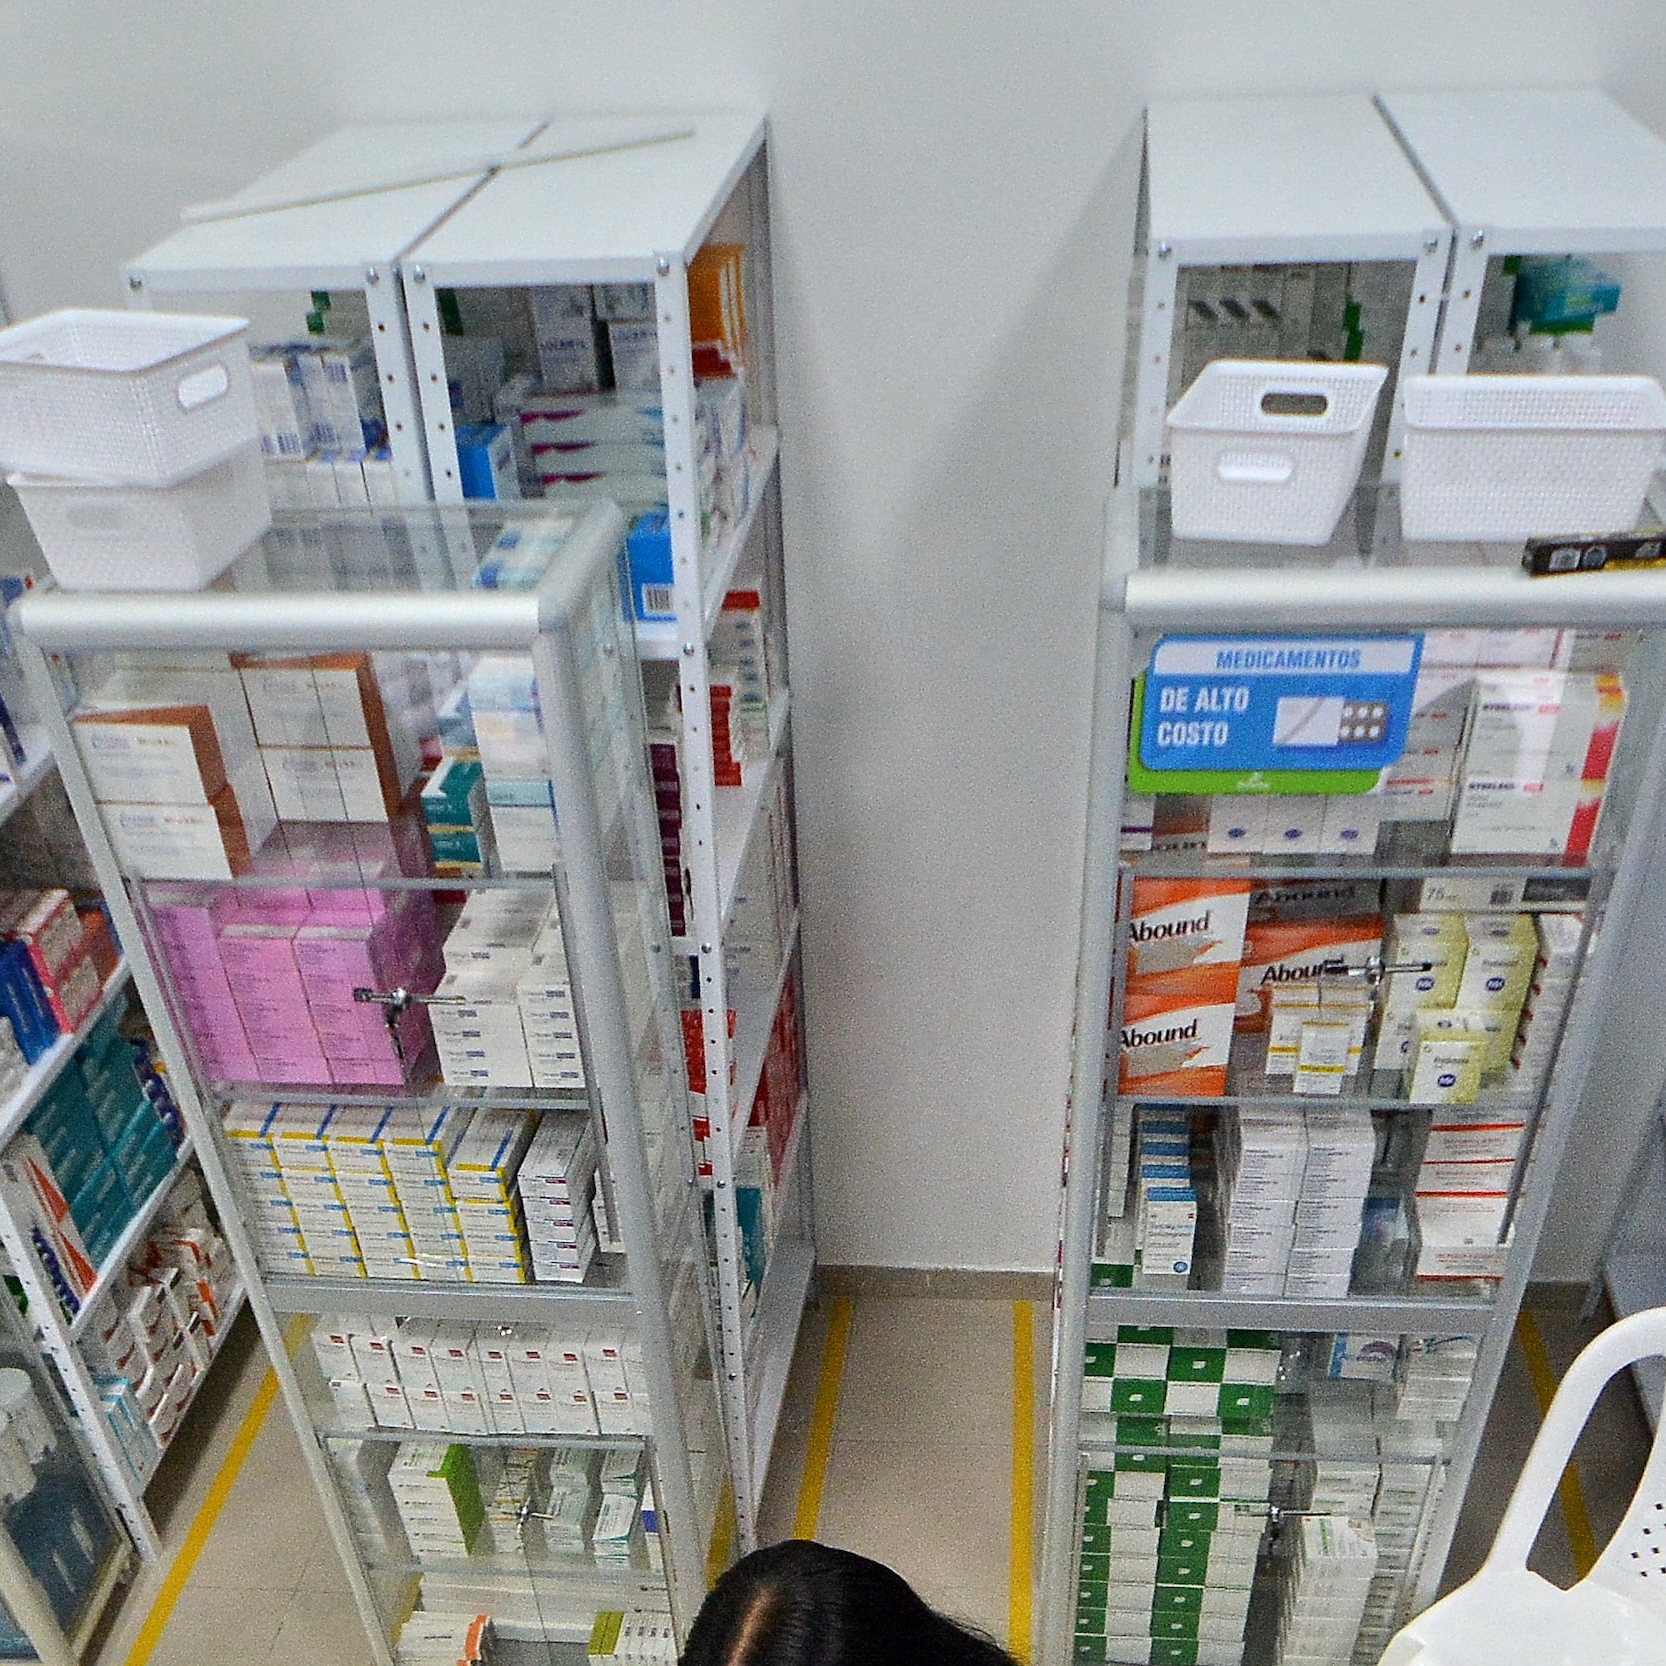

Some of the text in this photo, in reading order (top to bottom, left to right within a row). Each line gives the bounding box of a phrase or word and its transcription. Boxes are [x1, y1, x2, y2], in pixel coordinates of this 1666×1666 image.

[1216, 648, 1361, 669] MEDICAMENTOS
[1160, 686, 1249, 712] DE ALTO
[1157, 721, 1228, 747] COSTO
[1129, 909, 1212, 943] Abound
[1120, 1018, 1198, 1049] Abound
